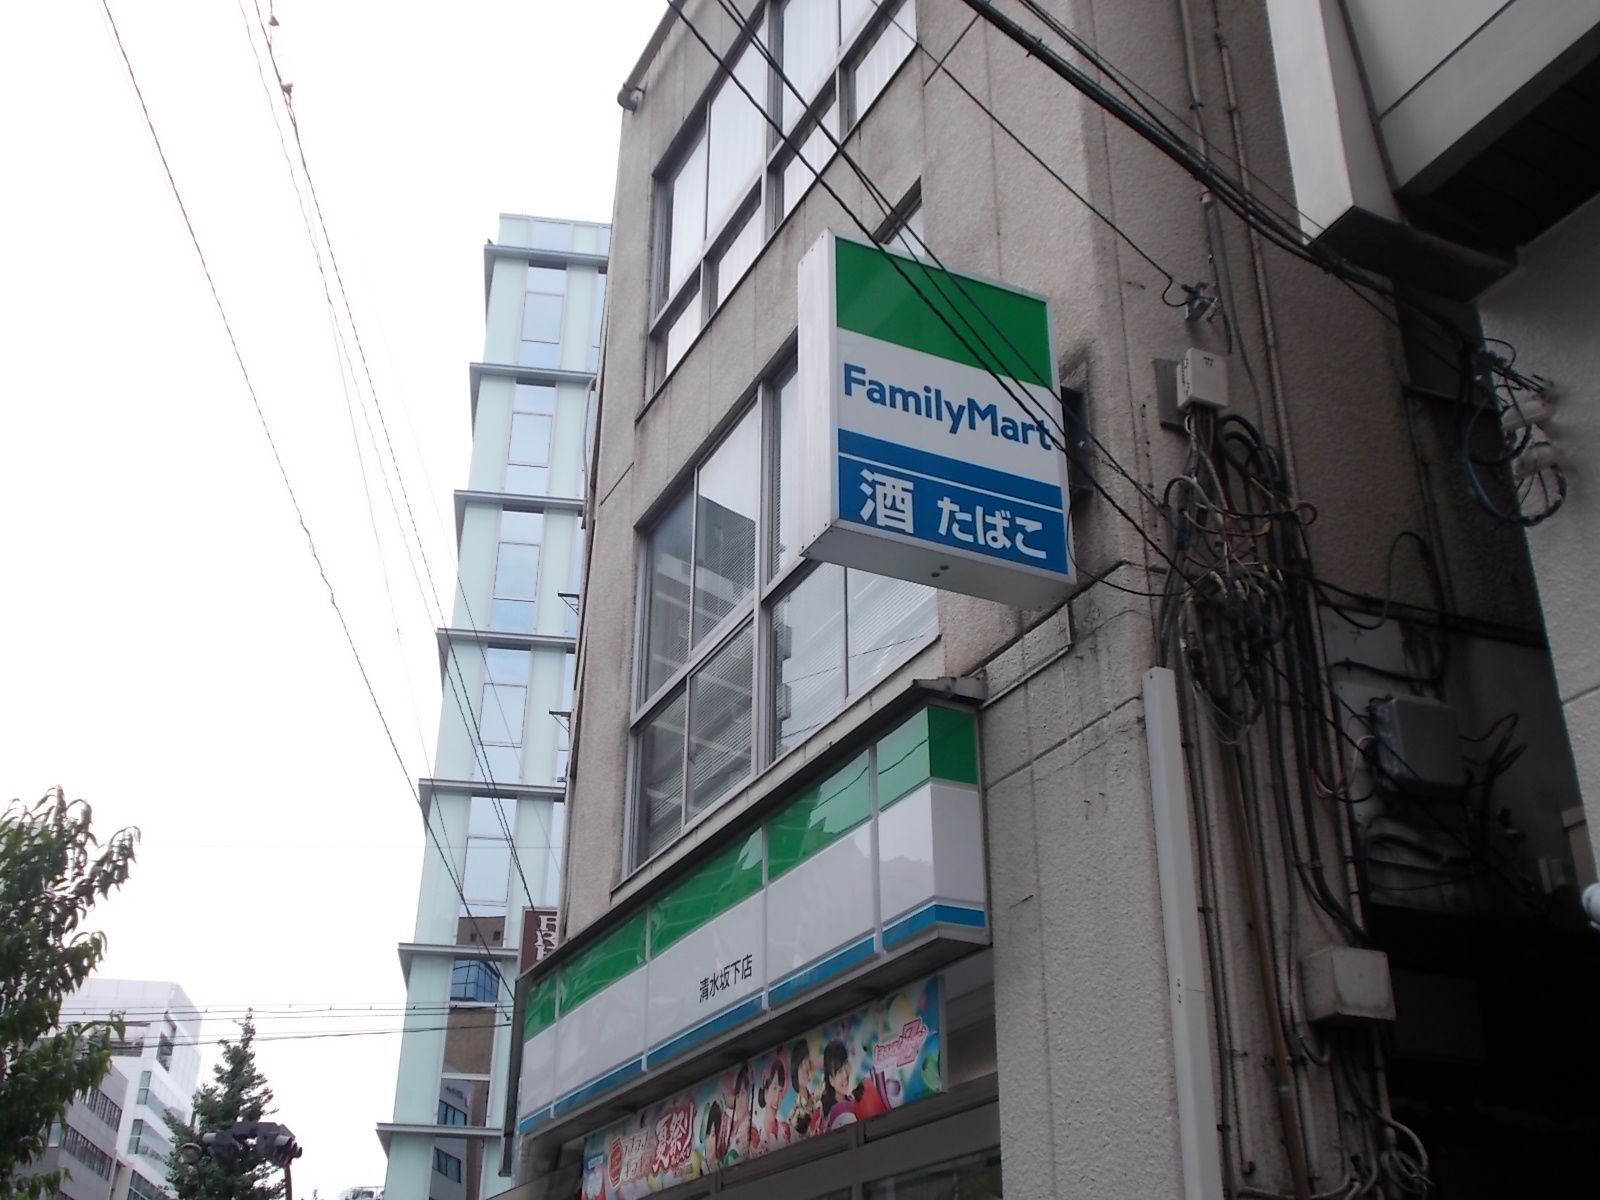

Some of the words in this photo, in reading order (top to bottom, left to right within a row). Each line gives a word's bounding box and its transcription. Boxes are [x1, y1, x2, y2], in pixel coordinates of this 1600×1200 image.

[844, 363, 1052, 450] FamilyMart
[859, 468, 915, 534] 酒
[937, 496, 1047, 560] たばこ
[699, 954, 753, 1003] 清水坂下店
